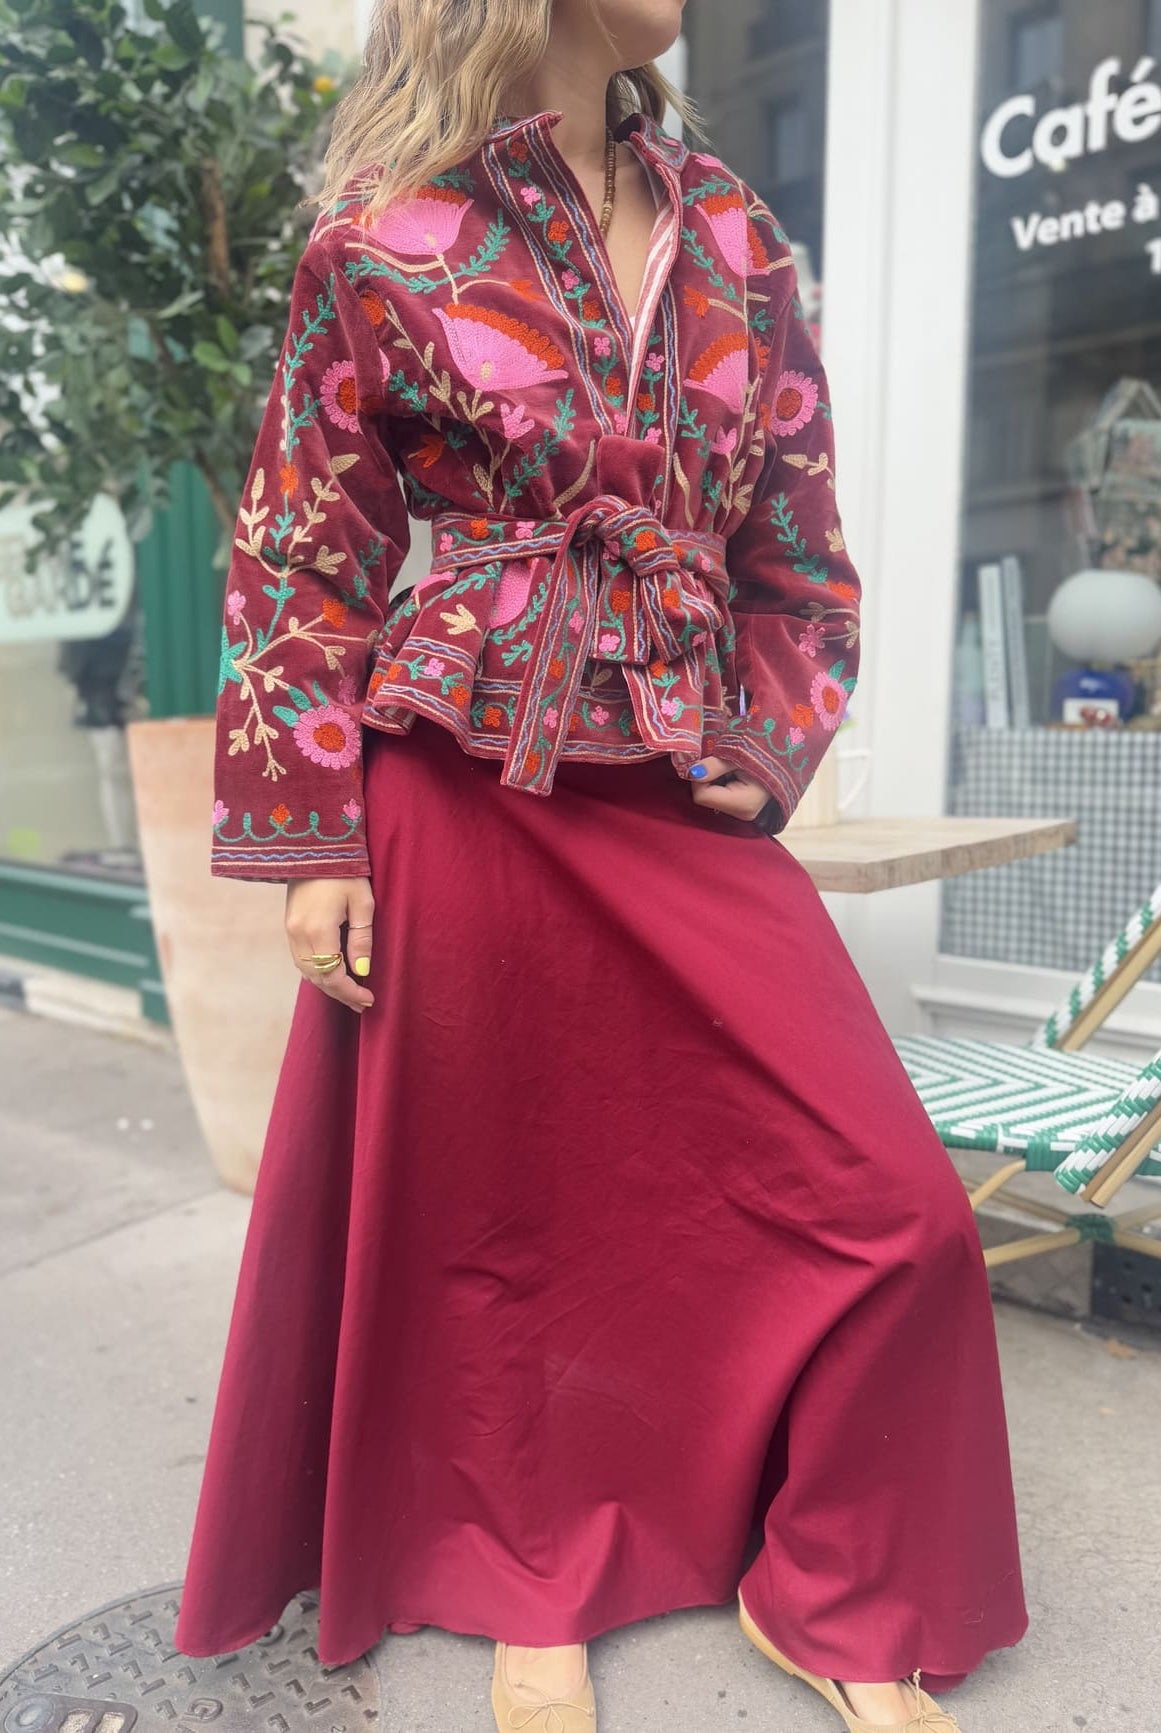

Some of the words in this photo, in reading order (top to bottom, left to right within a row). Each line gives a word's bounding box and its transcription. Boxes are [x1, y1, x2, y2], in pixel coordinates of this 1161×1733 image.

[981, 57, 1161, 178] Café
[1011, 200, 1126, 250] Vente
[1132, 182, 1159, 224] à
